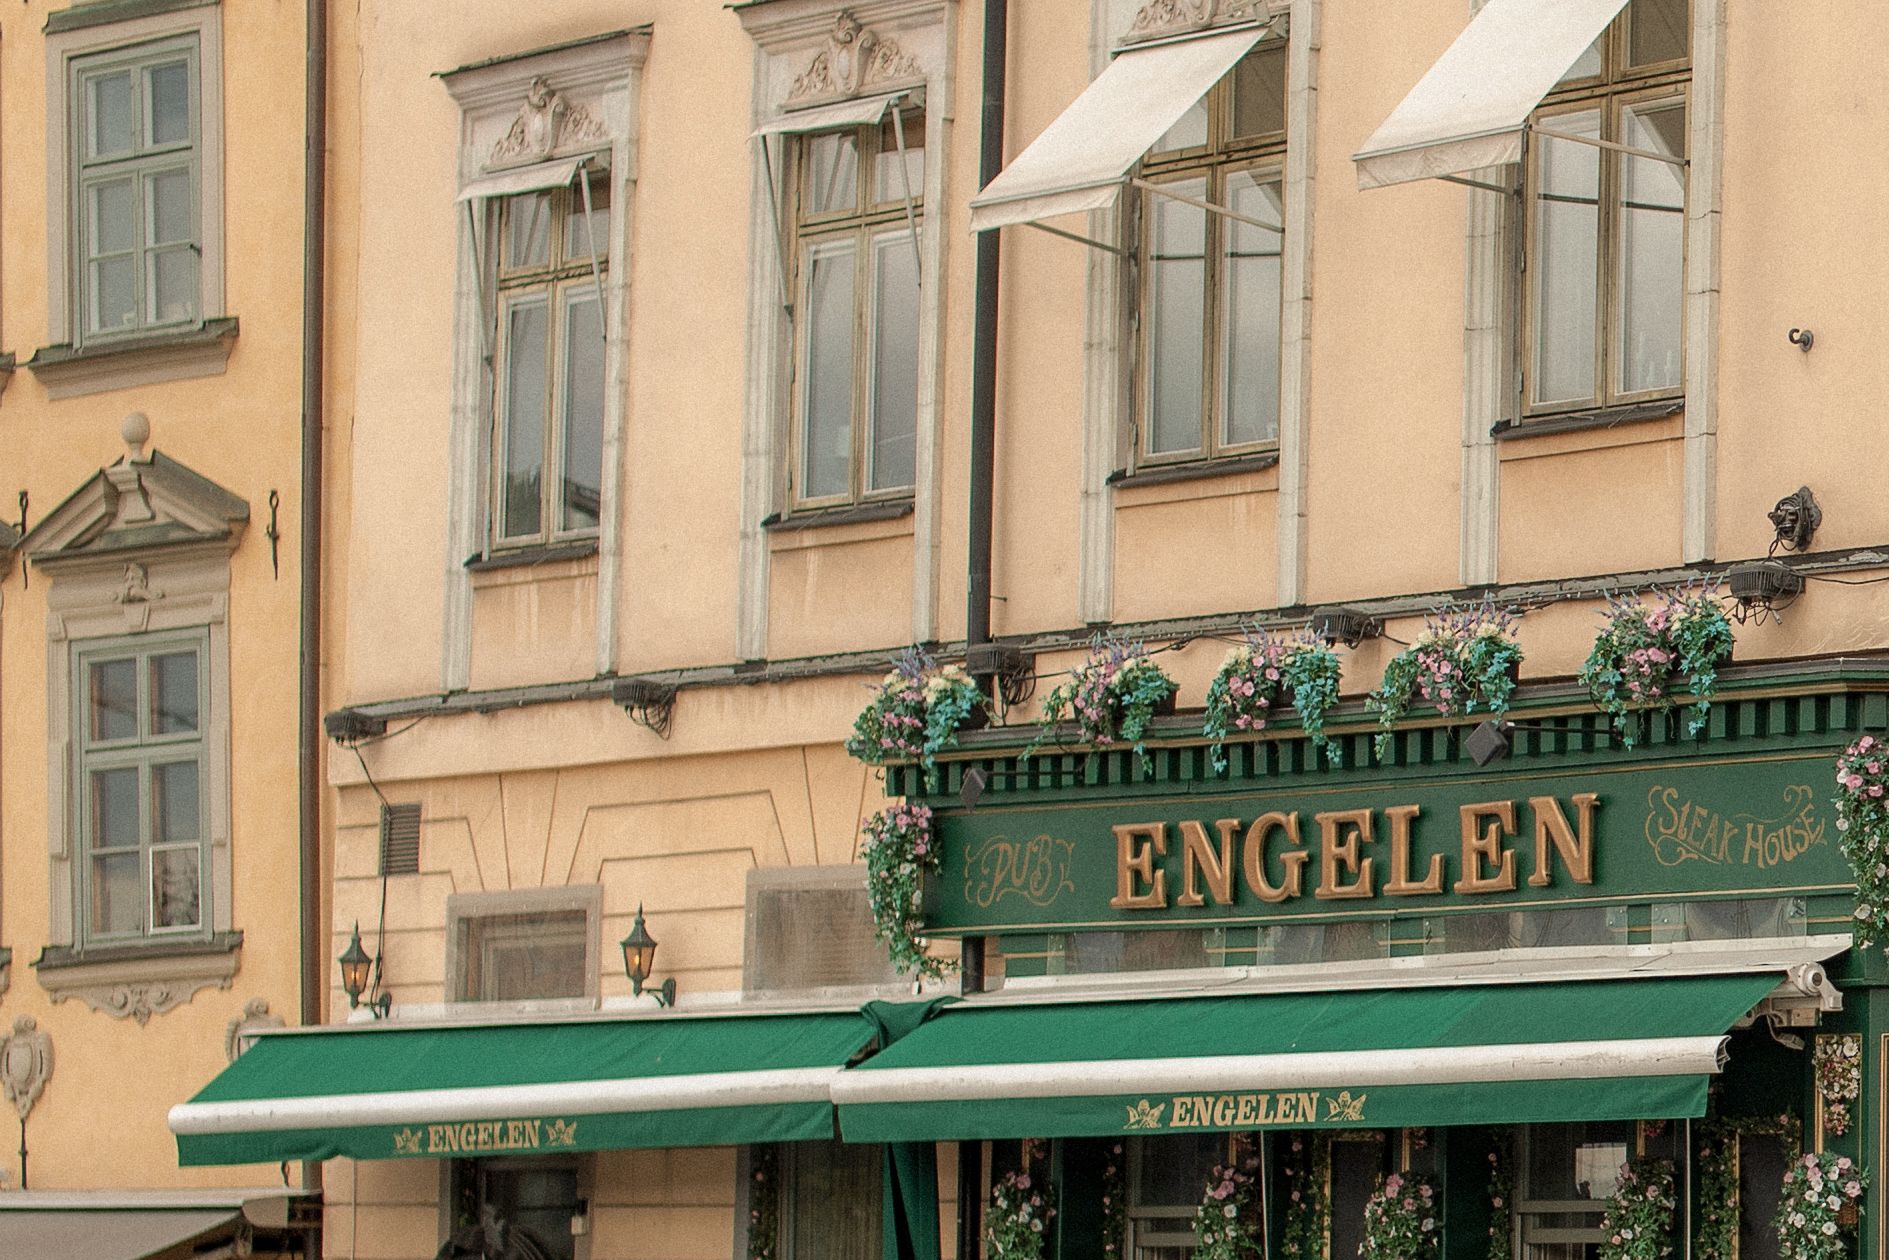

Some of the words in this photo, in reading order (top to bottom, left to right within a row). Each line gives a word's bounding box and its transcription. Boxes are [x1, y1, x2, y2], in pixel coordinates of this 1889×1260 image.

[1110, 793, 1601, 909] ENGELEN
[1742, 802, 1828, 870] HOUSE
[976, 833, 1053, 908] PUB
[427, 1119, 541, 1153] ENGELEN
[1169, 1092, 1320, 1128] ENGELEN
